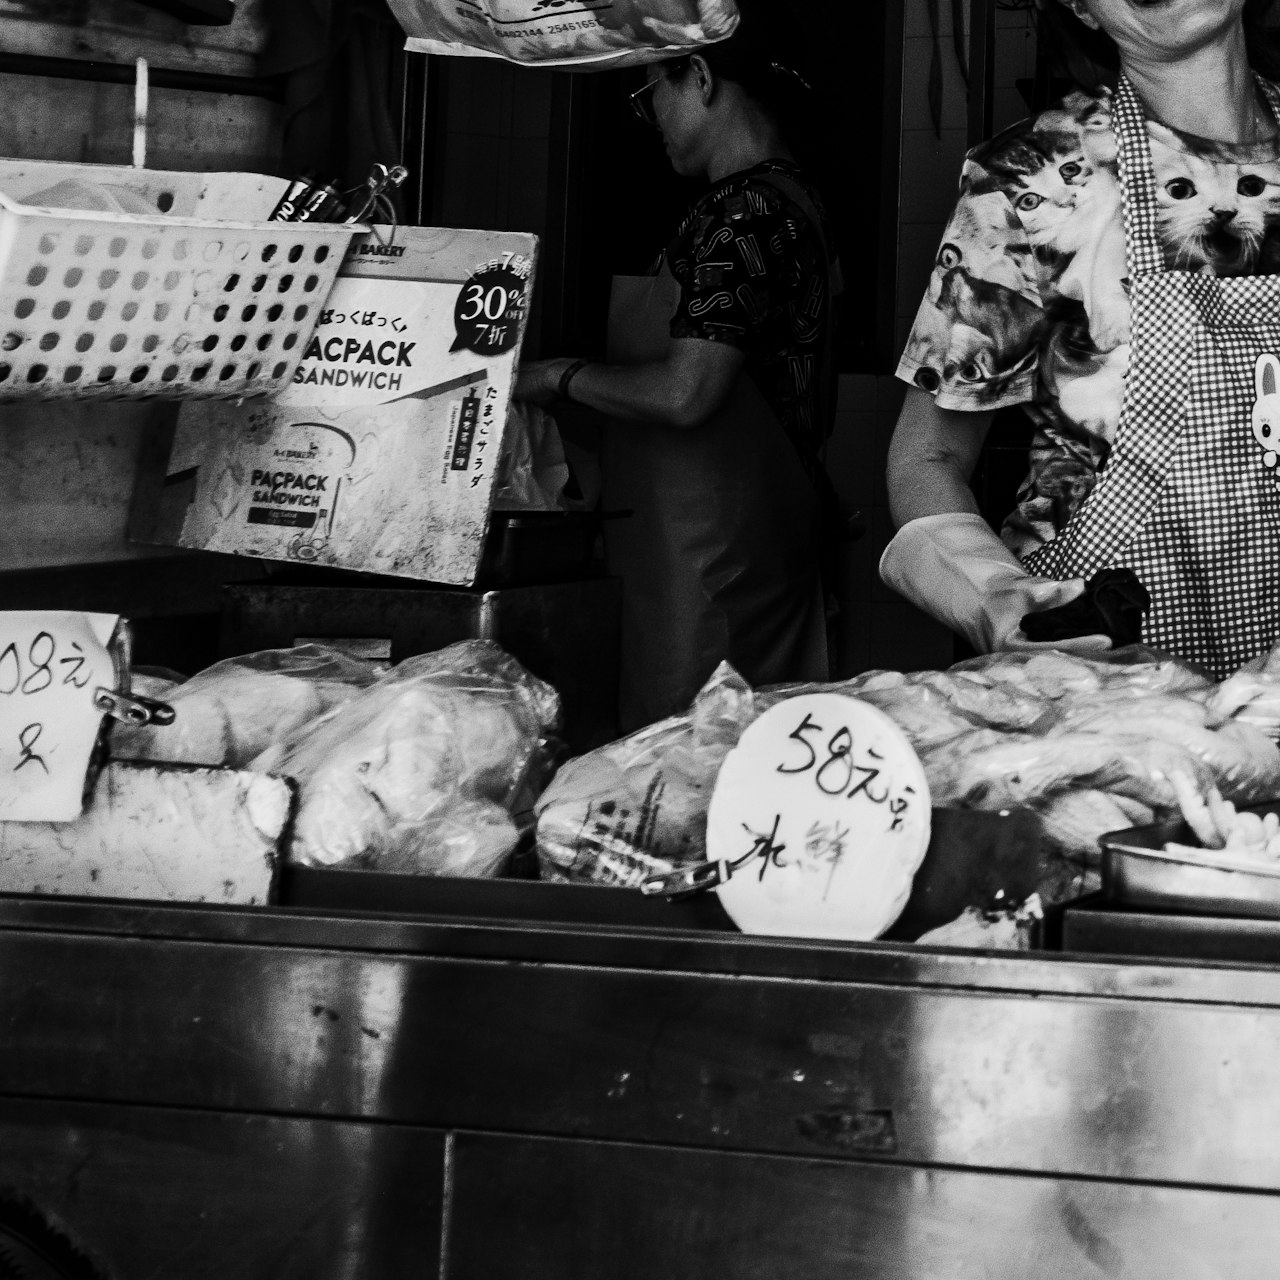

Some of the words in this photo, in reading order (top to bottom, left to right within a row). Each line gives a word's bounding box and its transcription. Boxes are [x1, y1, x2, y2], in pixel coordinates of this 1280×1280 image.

[360, 244, 407, 258] BAKERY
[473, 323, 508, 346] 7折
[302, 336, 417, 367] ACPACK
[293, 365, 403, 391] SANDWICH
[250, 469, 330, 492] PACPACK
